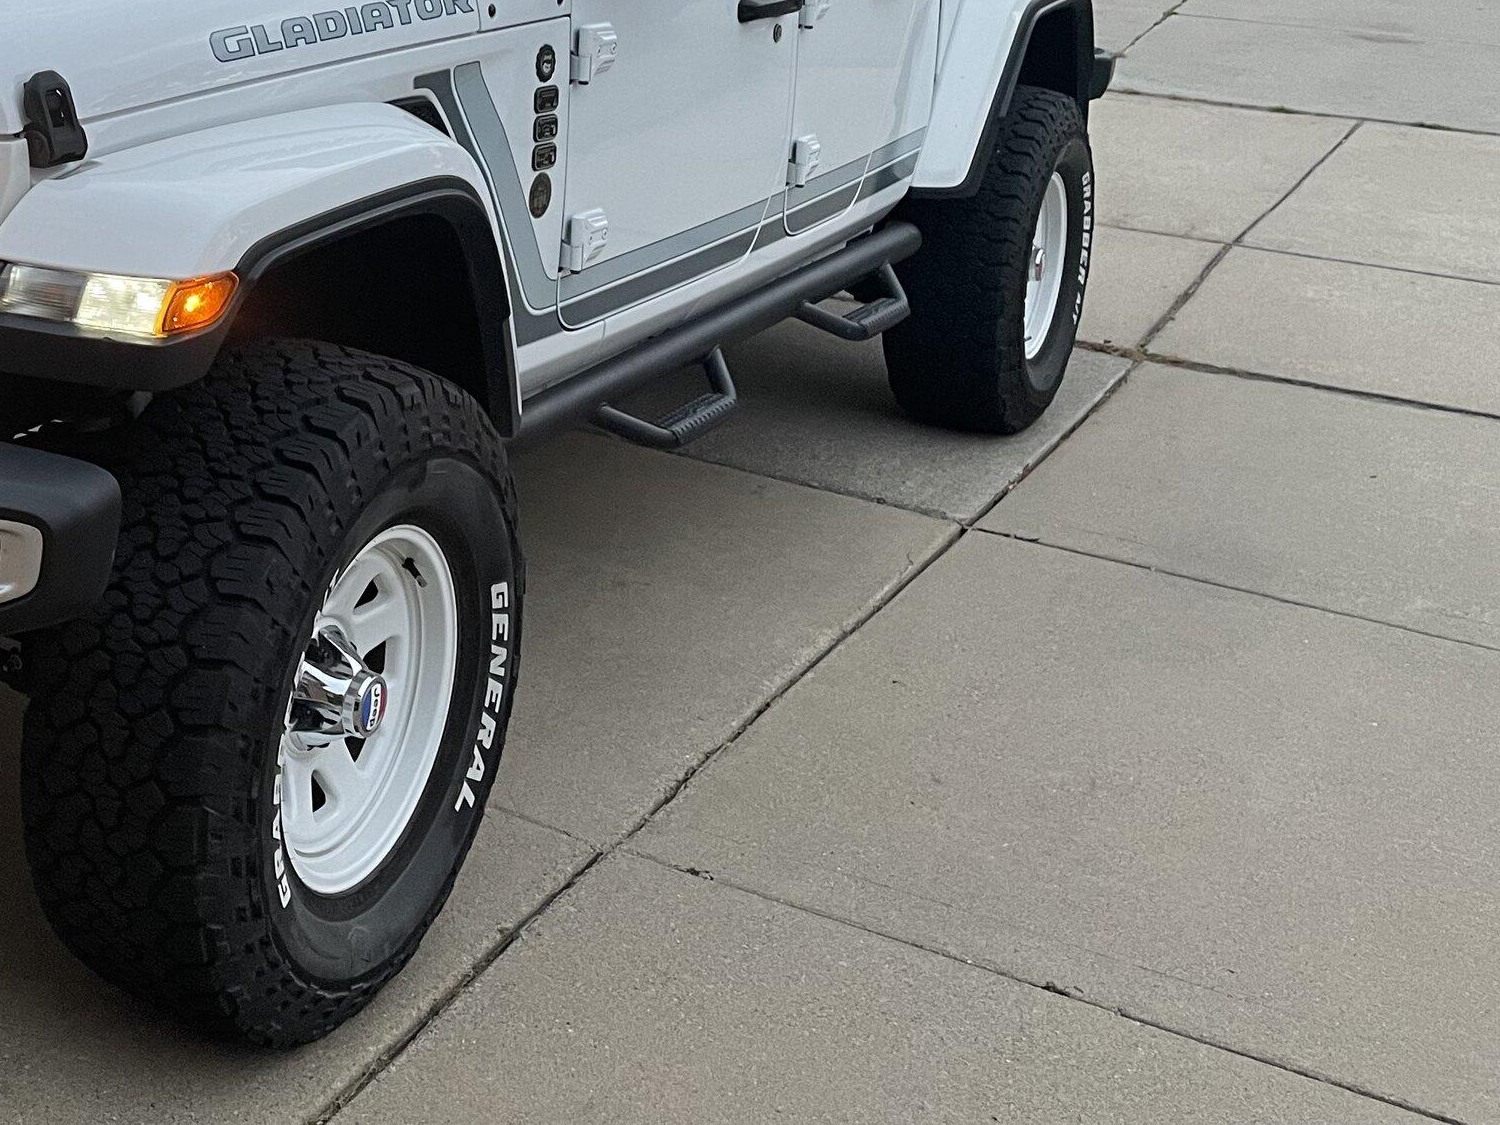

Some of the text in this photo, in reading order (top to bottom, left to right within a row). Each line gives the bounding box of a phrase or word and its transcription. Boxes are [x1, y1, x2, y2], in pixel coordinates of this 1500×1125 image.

[1078, 171, 1092, 285] GRABBER
[369, 687, 380, 728] Jeep
[453, 581, 510, 813] GENERAL
